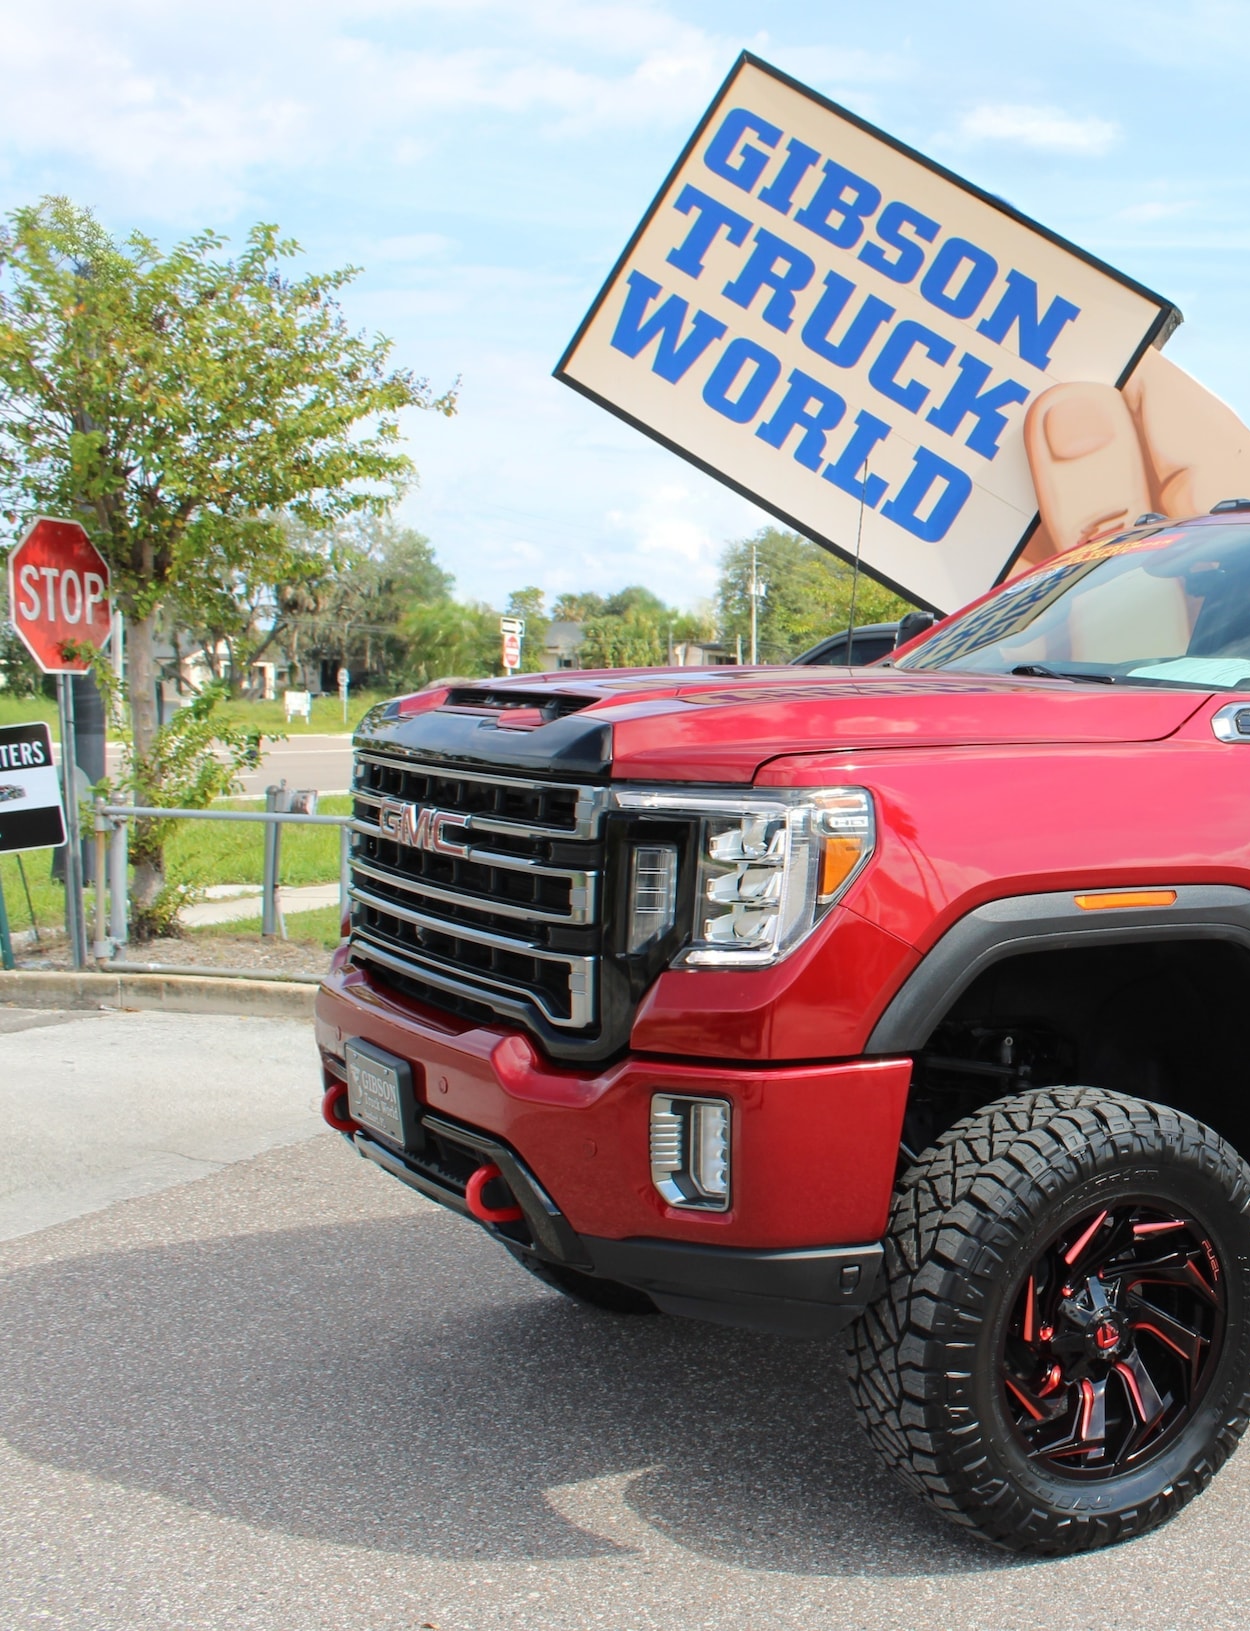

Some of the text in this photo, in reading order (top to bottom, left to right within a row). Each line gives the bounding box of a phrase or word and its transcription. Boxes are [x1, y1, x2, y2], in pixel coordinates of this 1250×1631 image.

[704, 108, 1080, 370] GIBSON
[666, 184, 1030, 460] TRUCK
[611, 270, 972, 542] WORLD
[19, 564, 105, 625] STOP
[0, 741, 46, 768] TERS
[380, 797, 472, 859] GMC
[361, 1070, 397, 1105] GIBSON
[1201, 1239, 1219, 1281] FUEL
